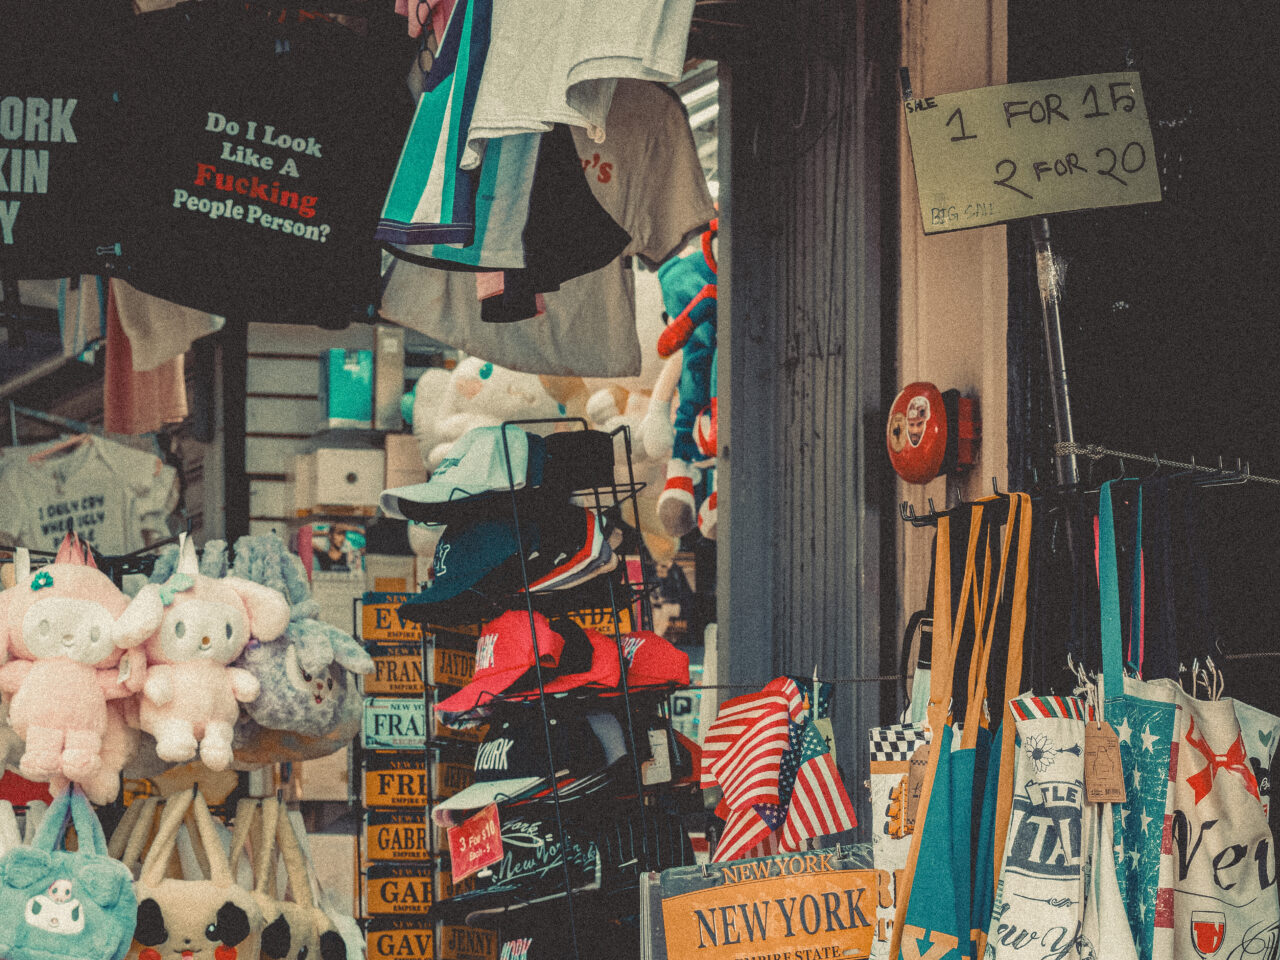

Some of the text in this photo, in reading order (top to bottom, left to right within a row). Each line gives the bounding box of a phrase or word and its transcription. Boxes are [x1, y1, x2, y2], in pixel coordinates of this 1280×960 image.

[205, 112, 322, 158] Do I Look
[946, 82, 1136, 141] 1 FOR 15
[220, 142, 300, 178] Like A
[994, 142, 1146, 199] 2 FOR 20
[173, 188, 331, 243] People Person?
[193, 163, 319, 218] Fucking
[722, 853, 834, 885] NEW YORK
[694, 900, 772, 949] NEW
[775, 888, 871, 937] YORK
